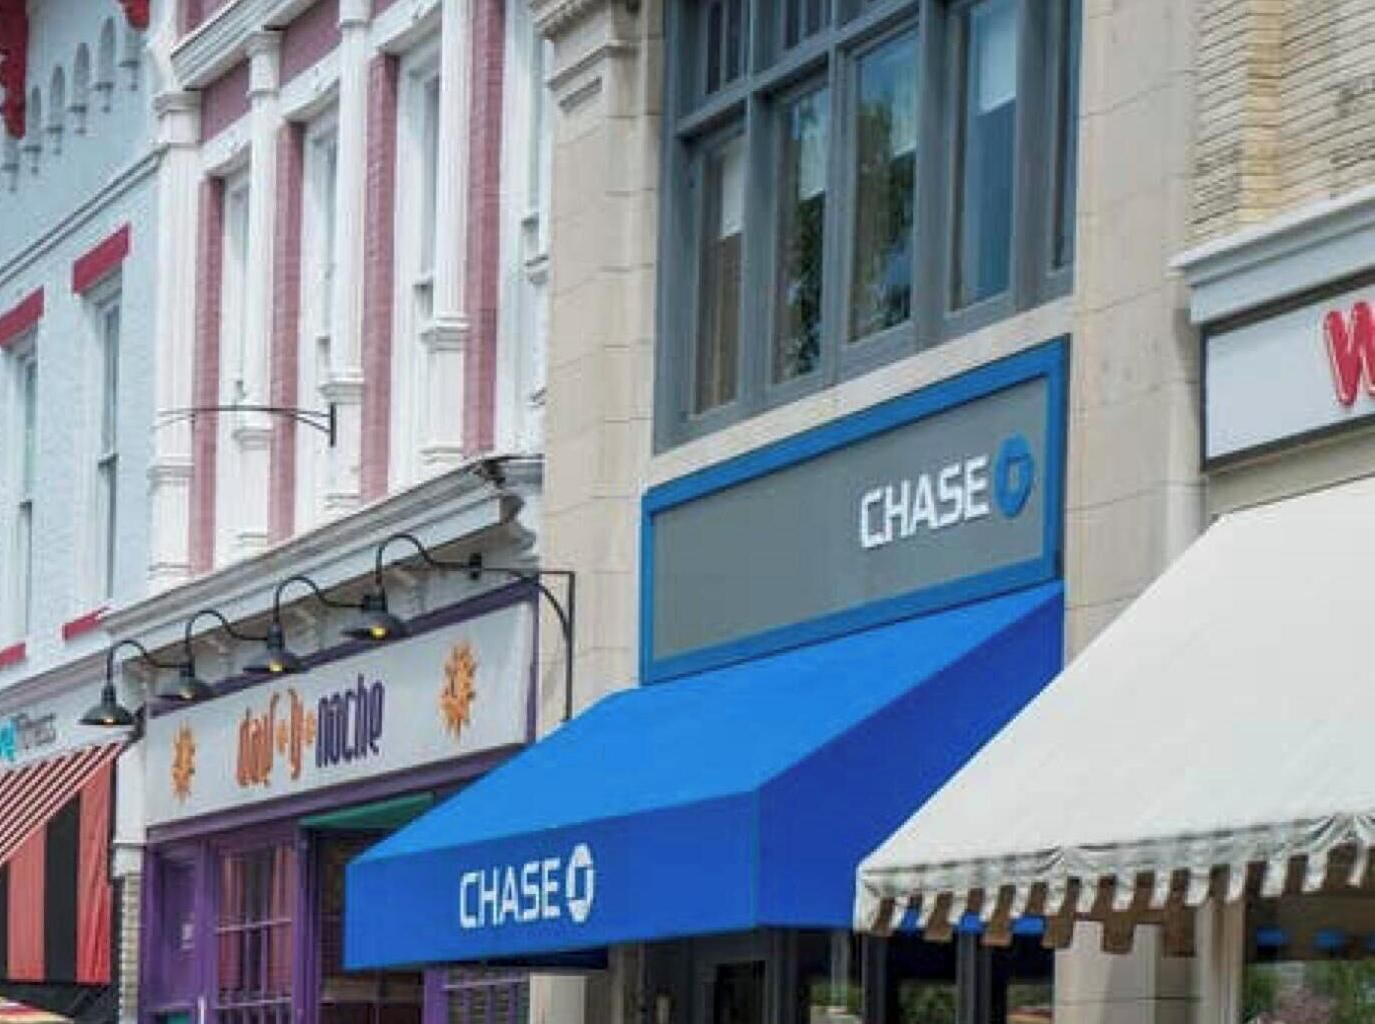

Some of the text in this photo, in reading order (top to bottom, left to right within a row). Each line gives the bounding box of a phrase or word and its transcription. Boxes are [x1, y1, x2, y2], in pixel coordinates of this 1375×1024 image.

[861, 454, 991, 549] CHASE
[315, 673, 385, 768] noche
[459, 856, 562, 930] CHASE
